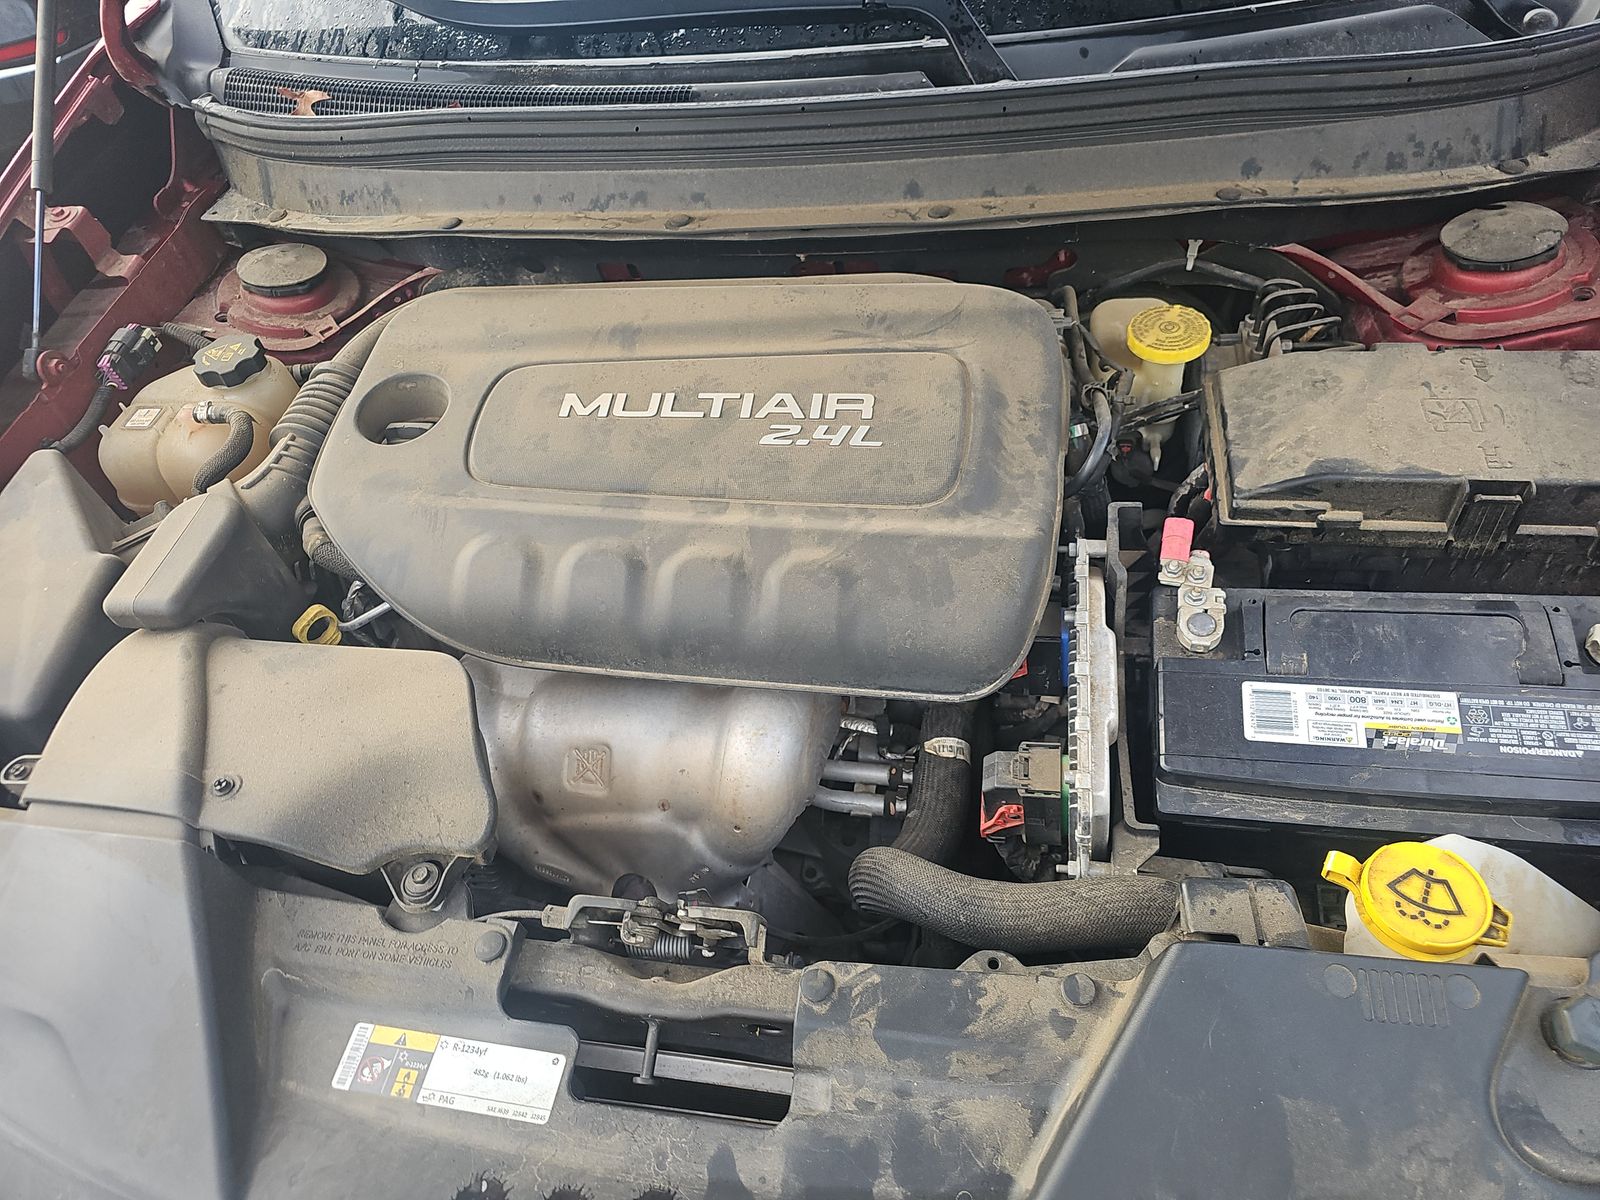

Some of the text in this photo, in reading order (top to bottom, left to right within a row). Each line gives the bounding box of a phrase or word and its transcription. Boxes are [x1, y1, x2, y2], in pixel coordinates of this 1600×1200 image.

[557, 392, 876, 420] MULTIAIR
[758, 424, 884, 447] 2.4L
[1349, 696, 1367, 704] 800
[1381, 736, 1448, 750] Duralast
[1499, 745, 1576, 757] DANGER/POISON
[297, 929, 459, 956] REMOVE THIS PANEL FOR ACCESS TO
[314, 945, 332, 956] FILL
[335, 947, 361, 959] PORT
[362, 950, 377, 961] ON
[378, 952, 406, 963] SOME
[408, 955, 453, 969] VEHICLES
[452, 1041, 488, 1057] R-1234yf
[473, 1068, 528, 1085] 482g (1.062 lbs)
[438, 1095, 456, 1105] PAG
